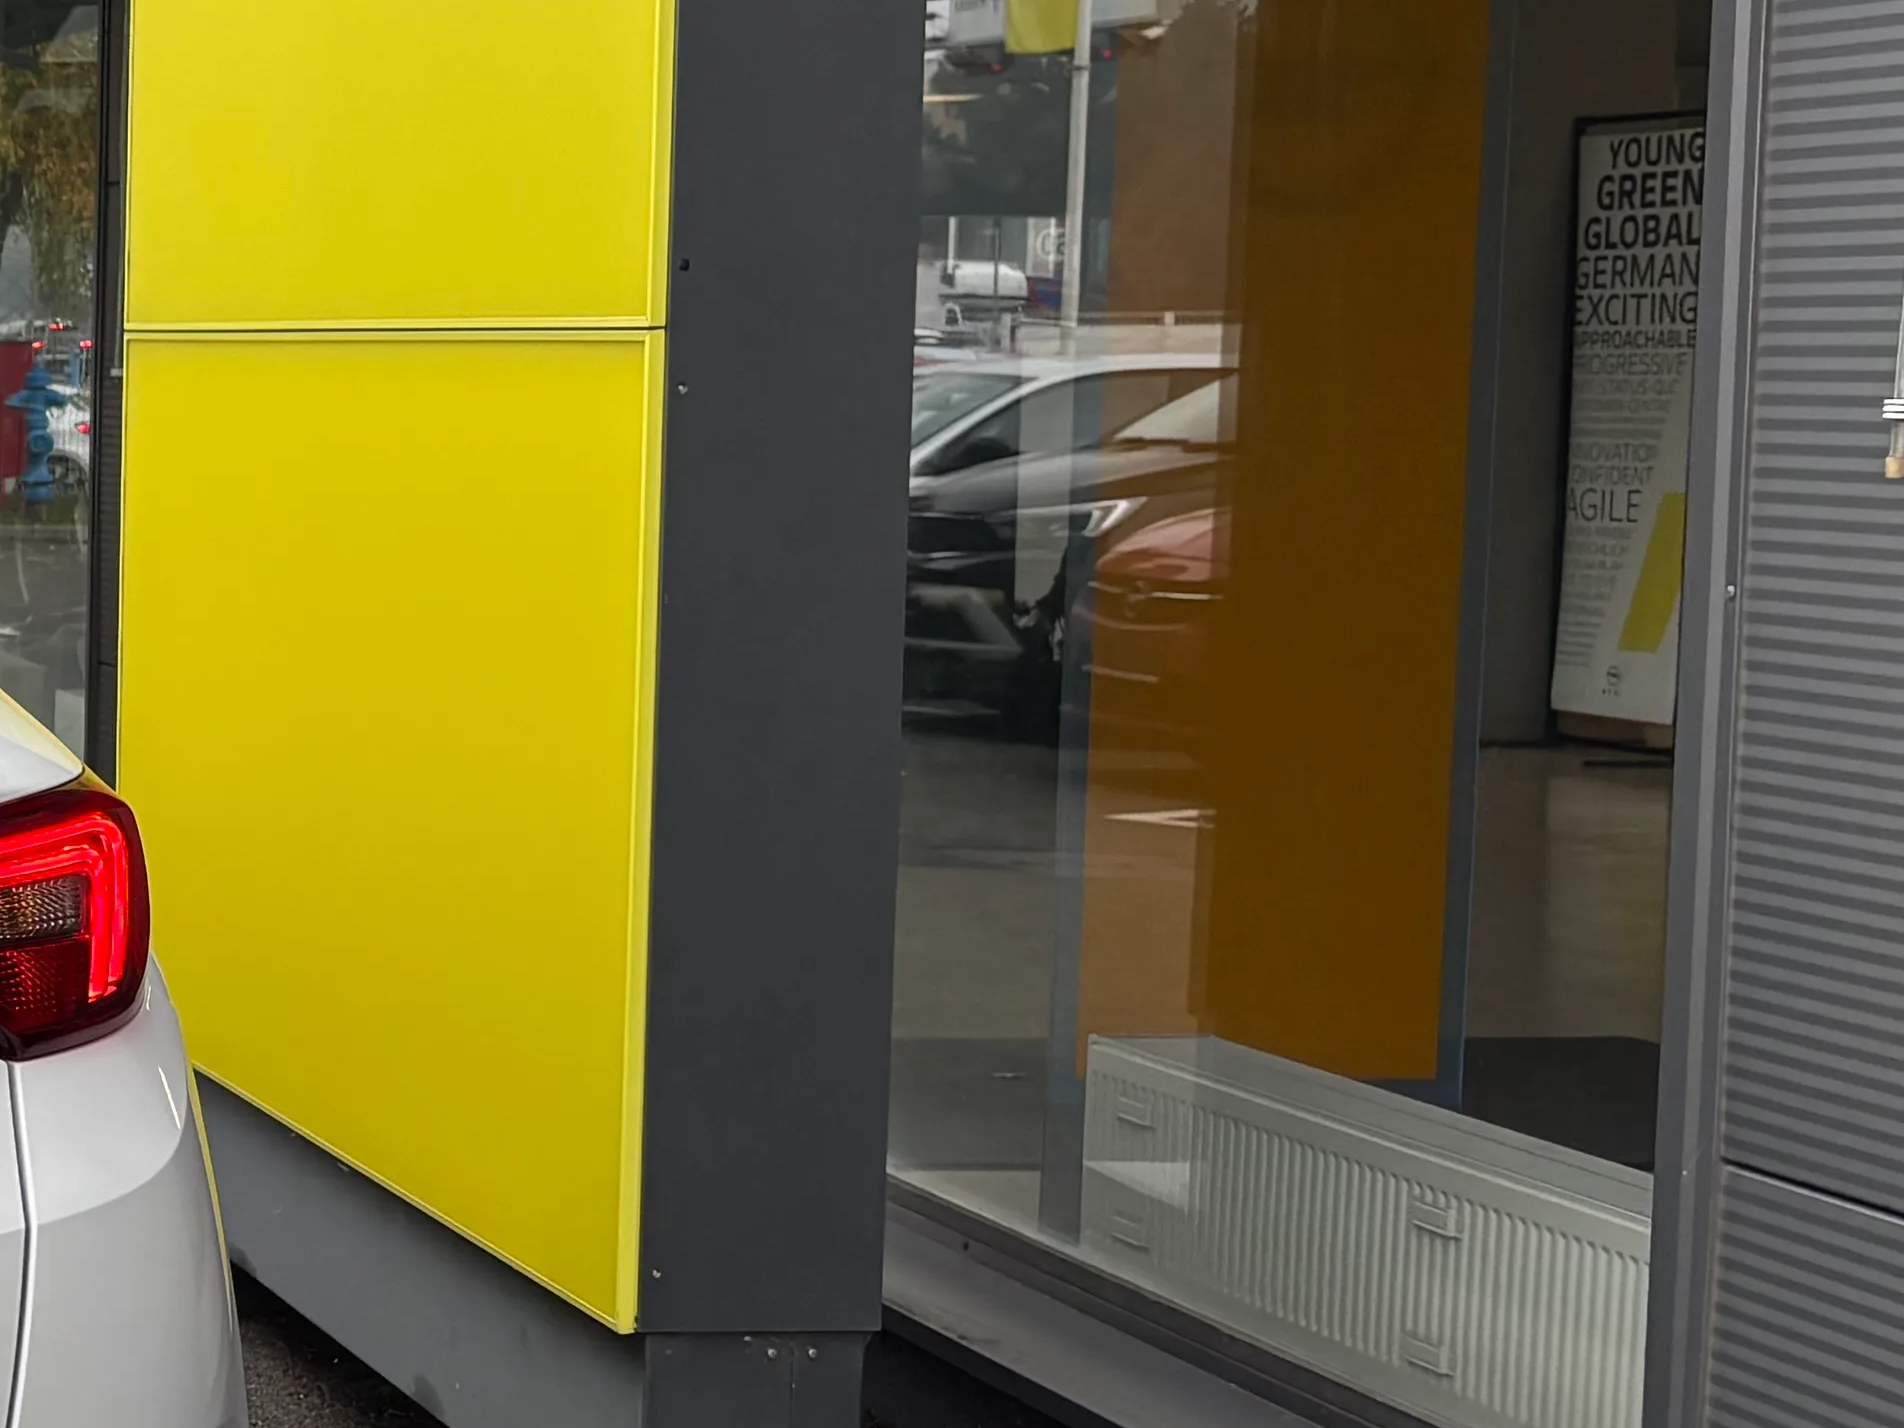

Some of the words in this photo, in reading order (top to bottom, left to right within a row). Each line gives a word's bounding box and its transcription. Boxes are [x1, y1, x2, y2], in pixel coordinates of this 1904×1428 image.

[1609, 132, 1705, 170] YOUNG
[1597, 169, 1703, 211] GREEN
[1584, 212, 1701, 251] GLOBAL
[1576, 249, 1700, 291] GERMAN
[1574, 292, 1698, 326] EXCITING
[1570, 465, 1654, 486] ONFIDENT
[1567, 487, 1643, 523] AGILE
